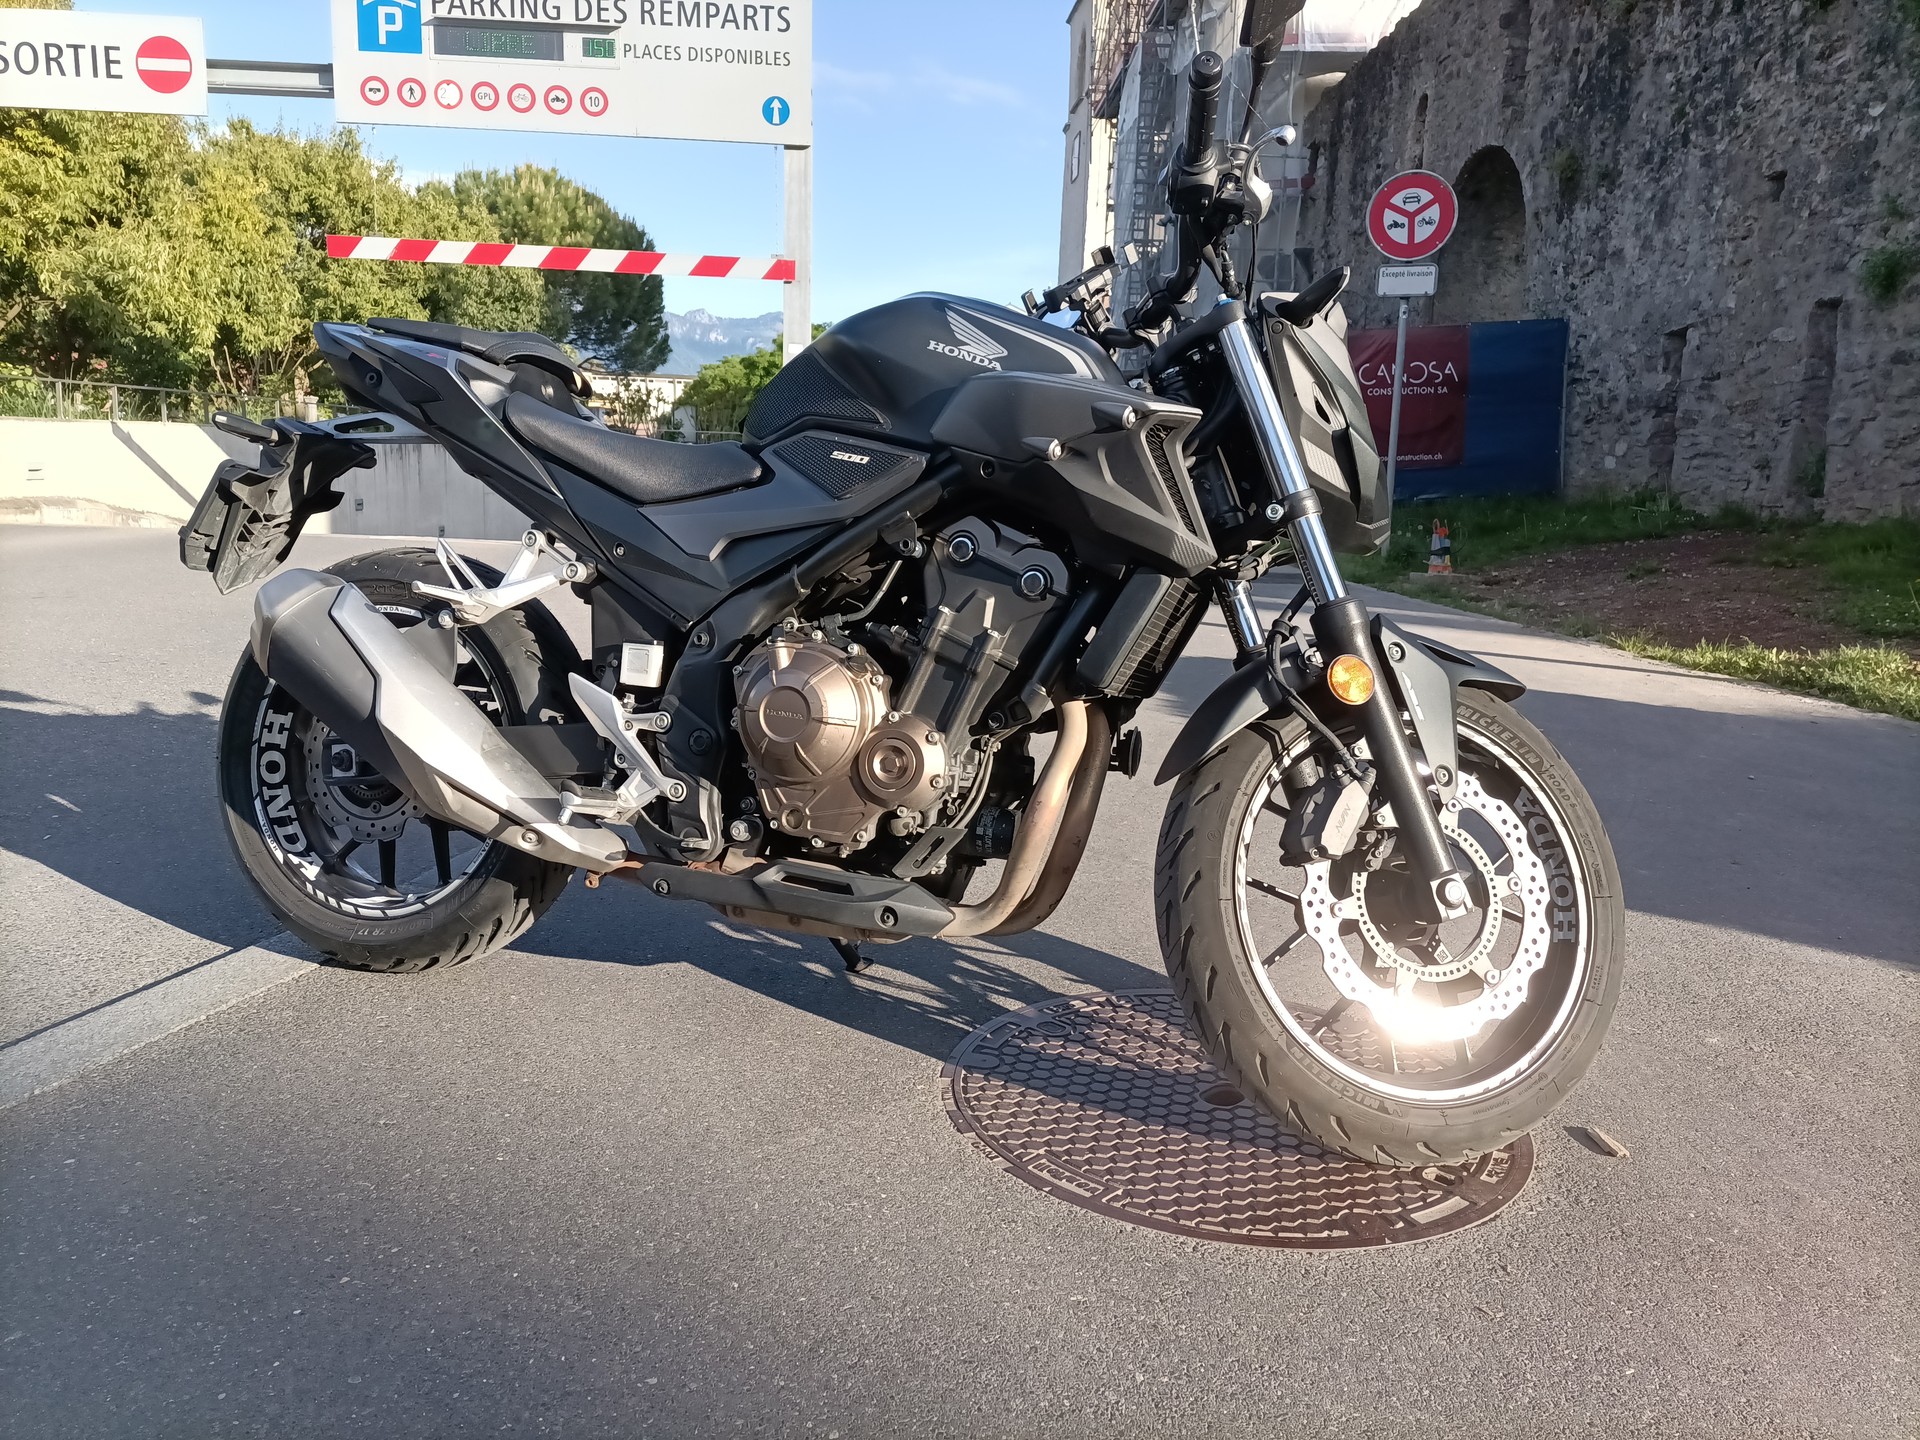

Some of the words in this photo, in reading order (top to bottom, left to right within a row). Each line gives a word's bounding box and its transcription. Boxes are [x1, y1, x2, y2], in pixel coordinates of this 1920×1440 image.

[574, 0, 628, 24] DES
[640, 0, 791, 33] REMPARTS
[623, 43, 682, 61] PLACES
[687, 46, 791, 67] DISPONIBLES
[477, 91, 493, 101] GPL
[588, 96, 600, 108] 10
[1381, 270, 1406, 279] Excepté
[1406, 269, 1433, 278] livraison
[926, 339, 1003, 372] HONDA
[1367, 386, 1435, 396] CONSUCTION
[1437, 386, 1448, 394] SA
[829, 450, 871, 465] 500
[1456, 704, 1541, 766] MICHELIN
[260, 708, 324, 882] HONDA
[1546, 770, 1571, 802] ROAD
[1512, 785, 1577, 943] HONDA
[1289, 1046, 1381, 1110] MICHELIN
